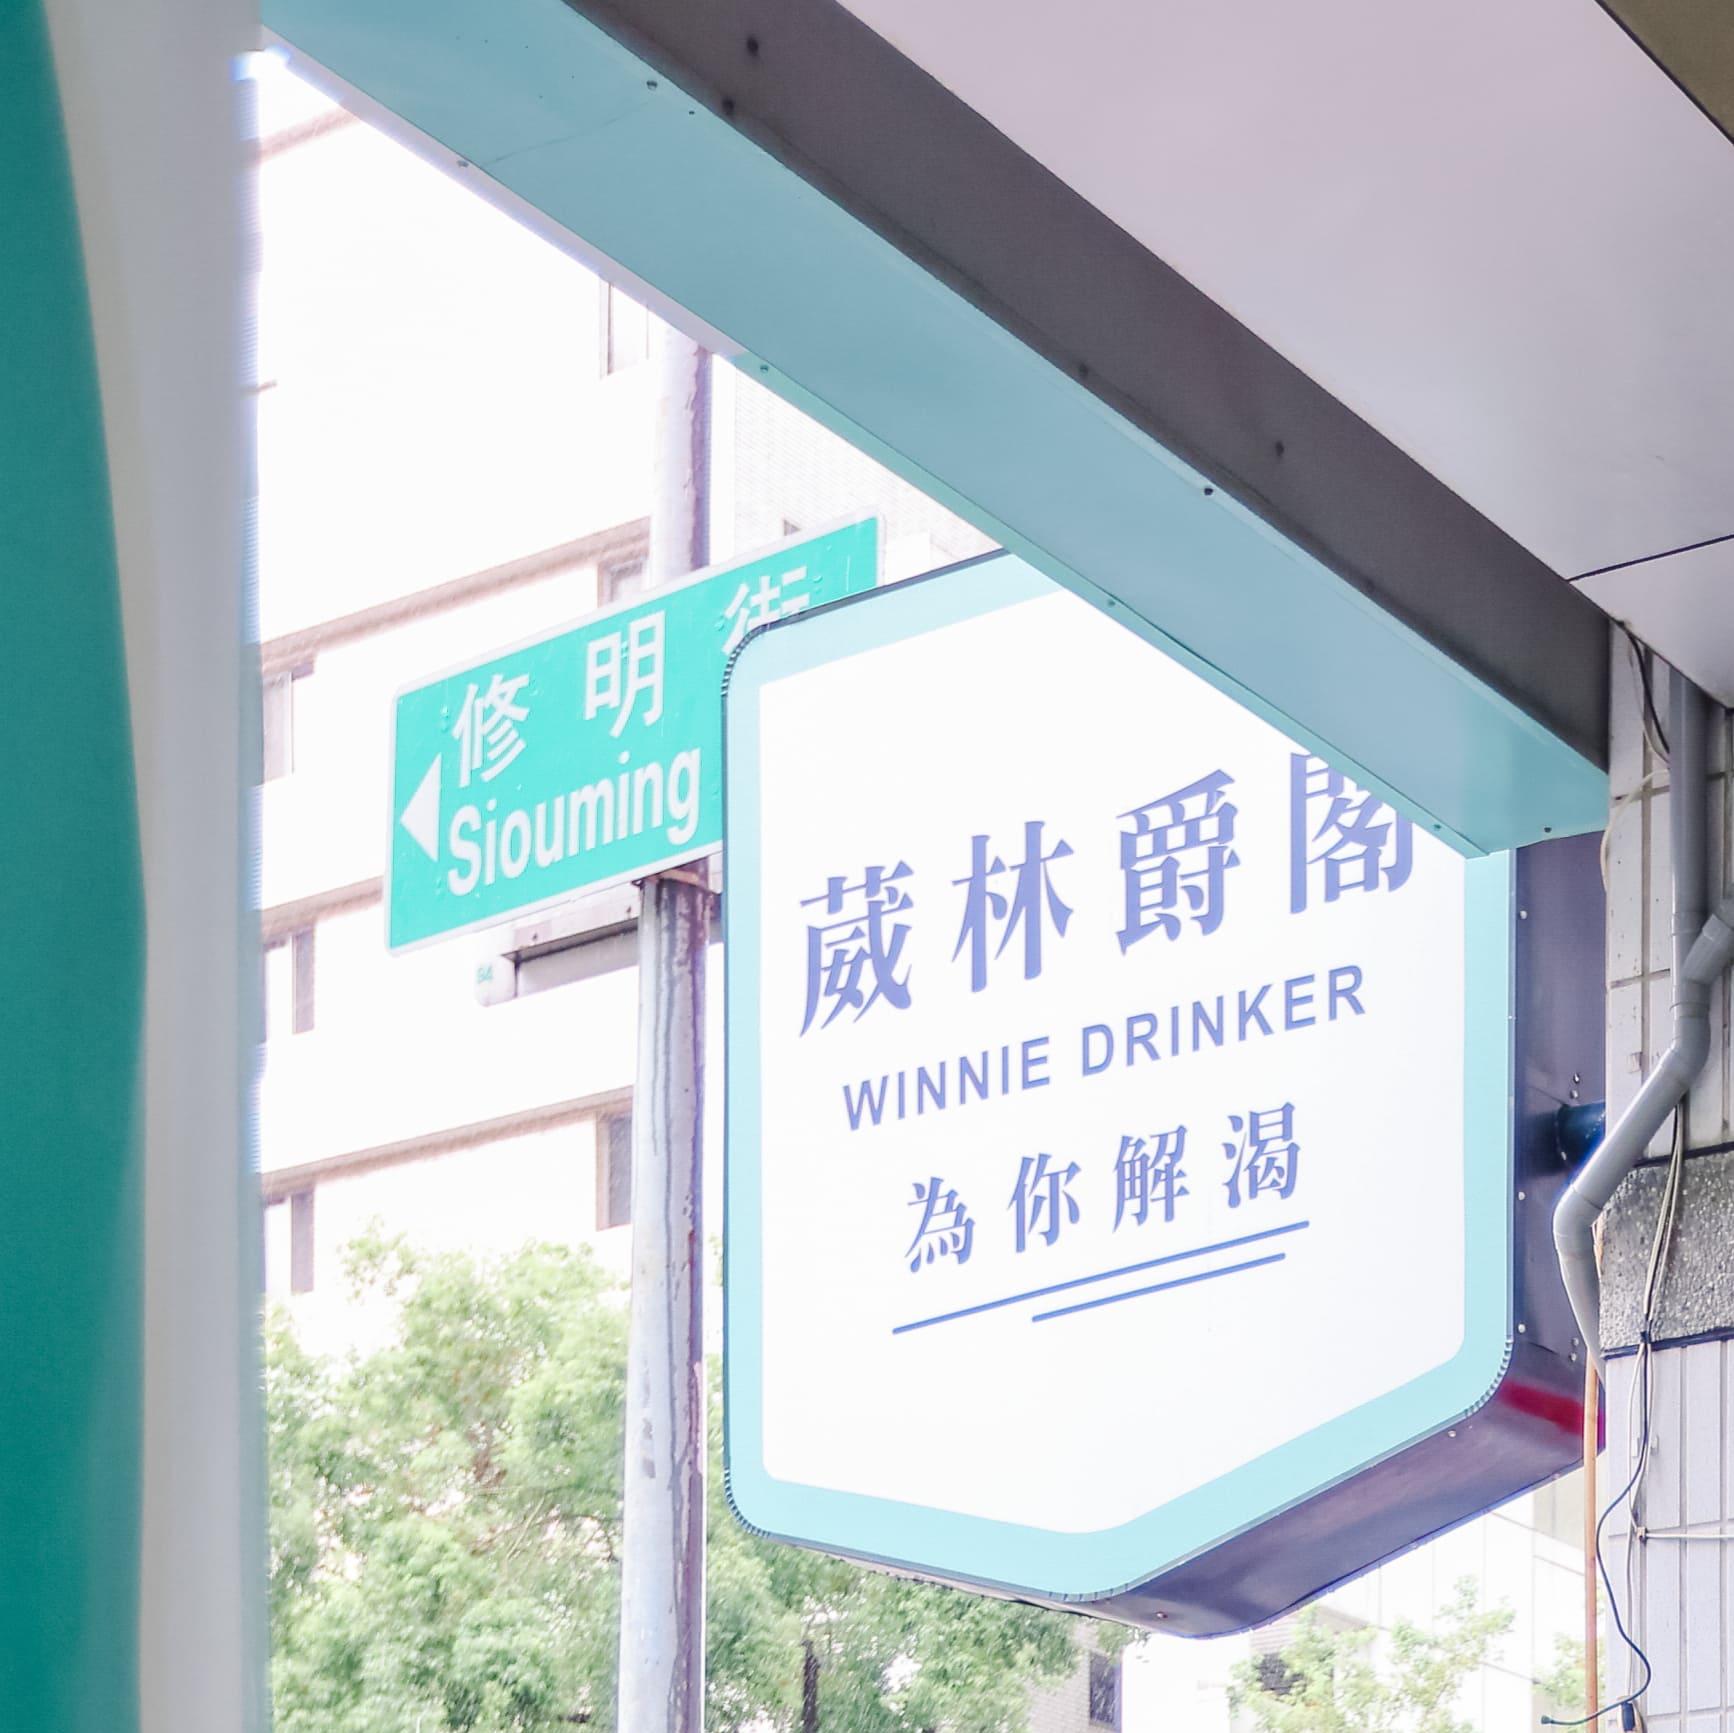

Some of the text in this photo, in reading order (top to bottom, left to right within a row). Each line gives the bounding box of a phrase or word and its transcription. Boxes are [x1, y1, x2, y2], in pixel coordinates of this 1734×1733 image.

[447, 747, 701, 896] Siouming
[800, 752, 1415, 1037] 葳林爵閣
[842, 964, 1366, 1132] WINNIE DRINKER
[903, 1101, 1301, 1274] 為你解渴
